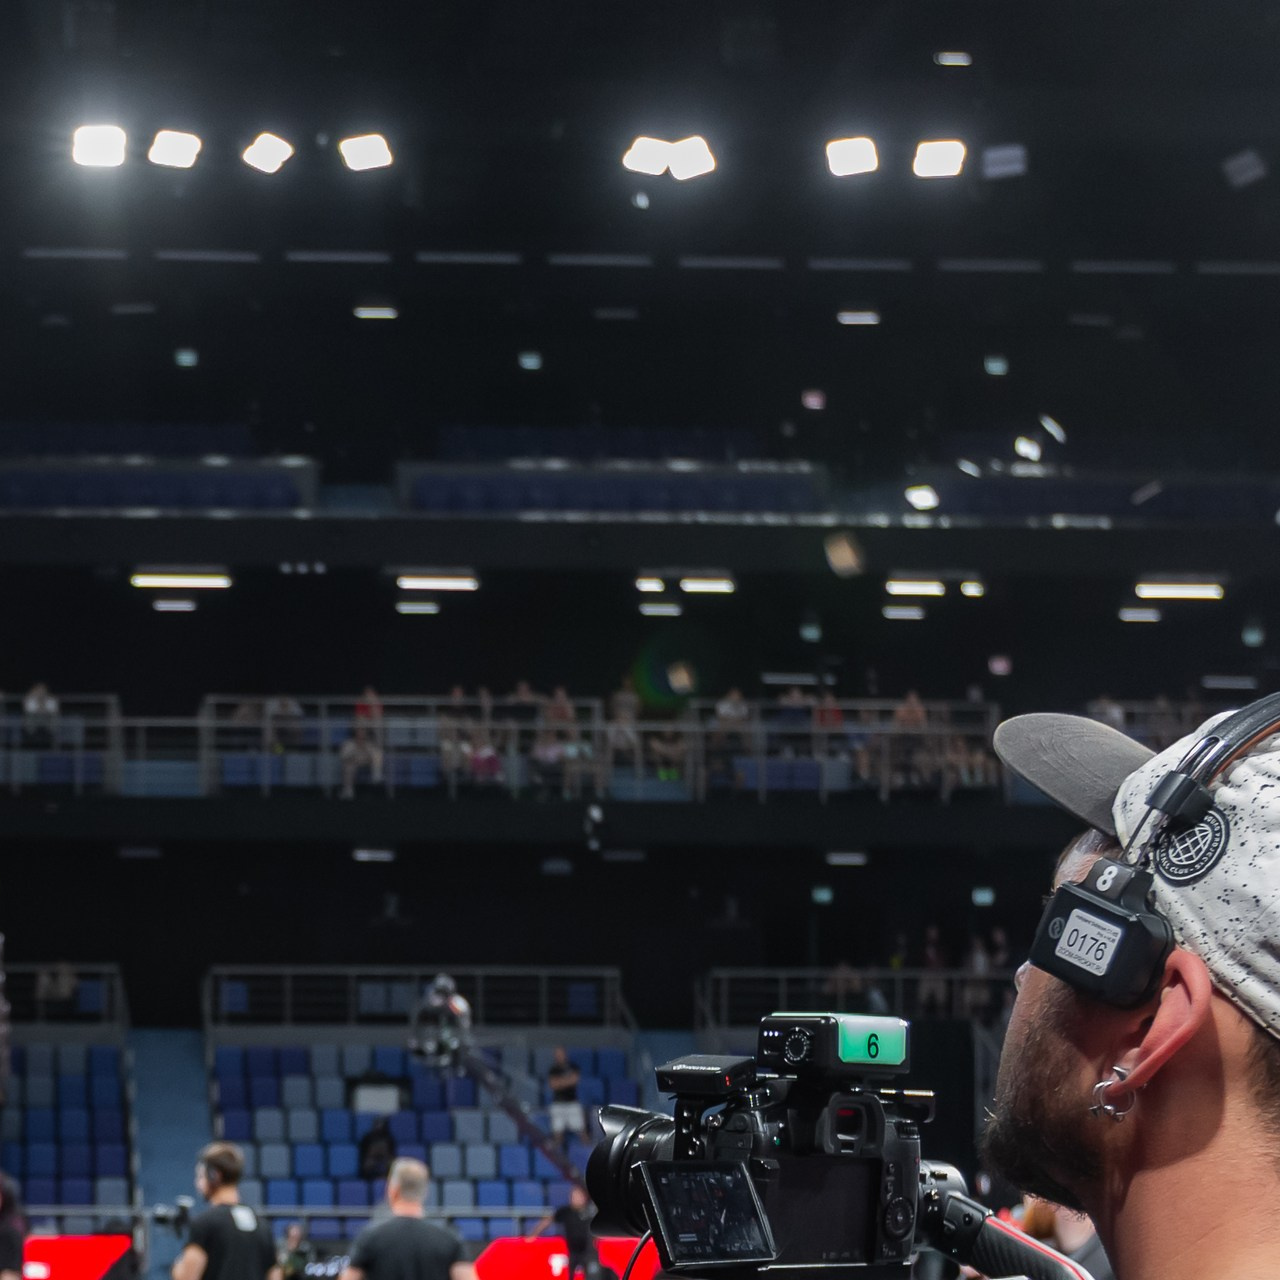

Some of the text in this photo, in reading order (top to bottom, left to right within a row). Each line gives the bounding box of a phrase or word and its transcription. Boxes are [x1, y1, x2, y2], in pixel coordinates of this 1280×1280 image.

[1096, 865, 1118, 891] 8
[1066, 928, 1108, 961] 0176
[867, 1033, 880, 1059] 6
